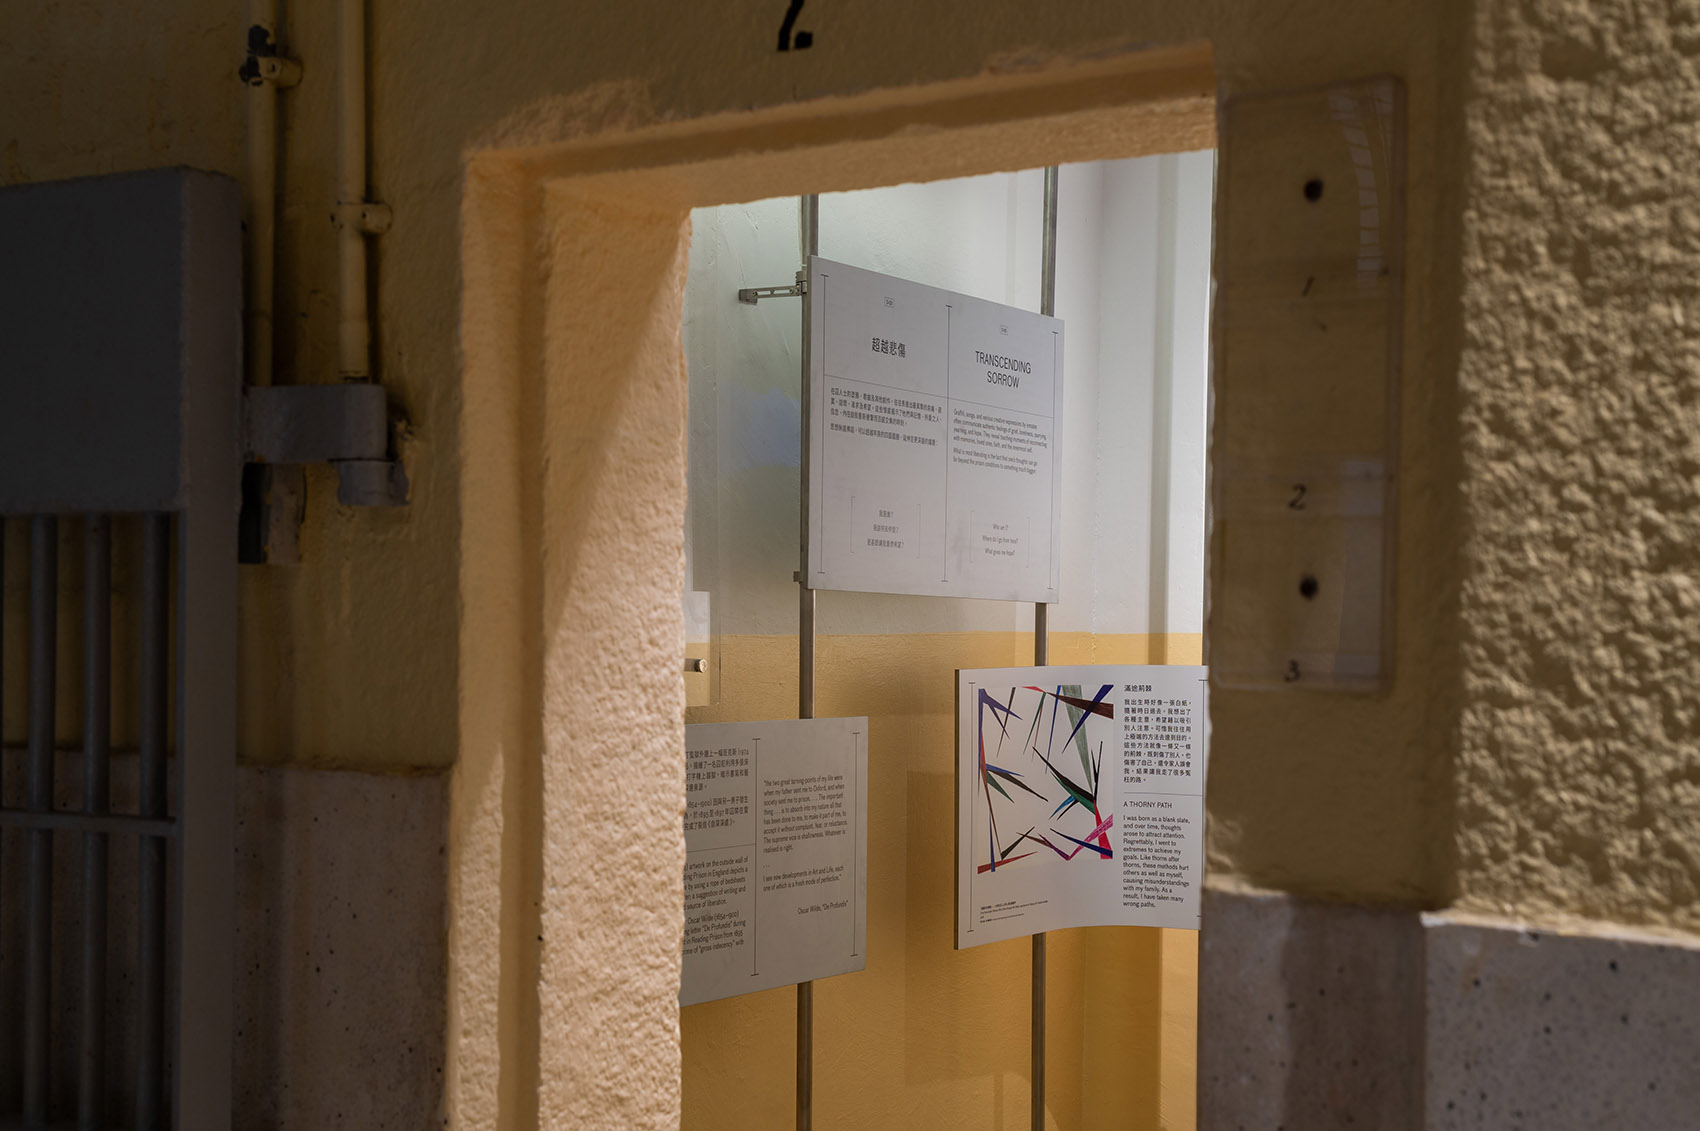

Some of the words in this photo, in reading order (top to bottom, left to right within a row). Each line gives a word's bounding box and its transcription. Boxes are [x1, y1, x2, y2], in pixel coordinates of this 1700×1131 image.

[872, 337, 906, 358] 超越悲傷
[975, 350, 1031, 374] TRANSCENDING
[987, 371, 1020, 388] SORROW
[1288, 483, 1307, 511] 2
[1160, 824, 1182, 832] thoughts
[1123, 838, 1154, 847] Regrettably,
[1123, 854, 1139, 862] goals.
[1166, 871, 1183, 879] myself,
[1123, 877, 1143, 885] causing
[1144, 878, 1189, 888] misunderstandings
[1144, 885, 1160, 894] family.
[1141, 900, 1156, 909] paths.
